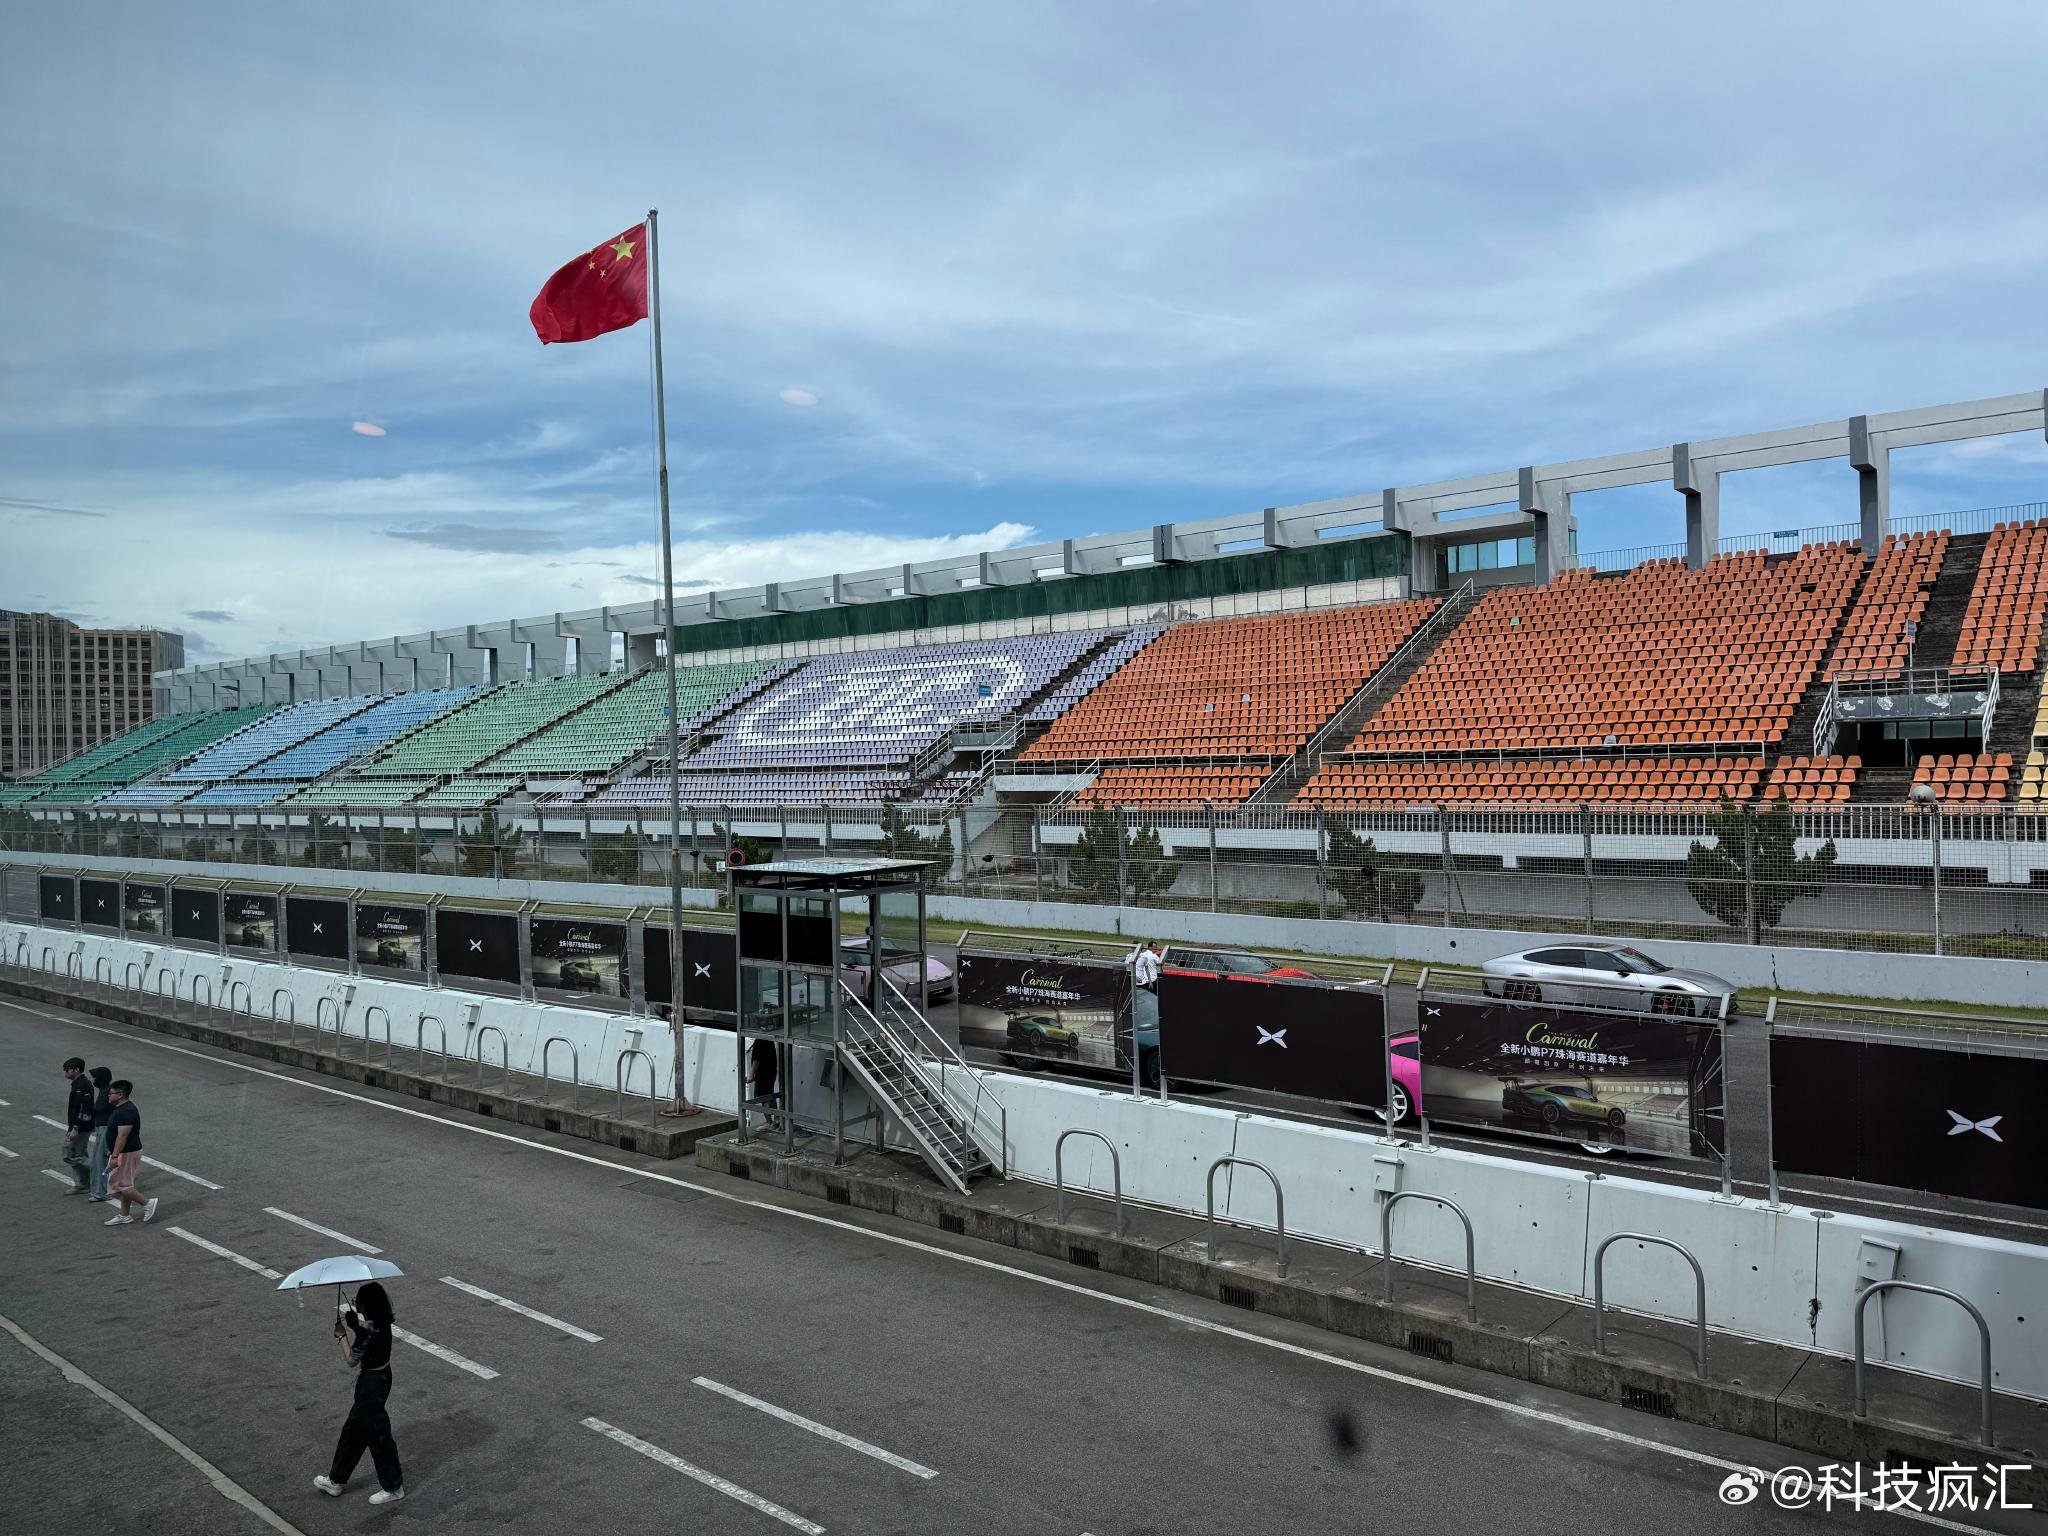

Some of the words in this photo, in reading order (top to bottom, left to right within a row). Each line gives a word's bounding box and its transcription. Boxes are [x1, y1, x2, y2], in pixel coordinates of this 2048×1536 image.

[1020, 968, 1063, 989] Carnival
[1525, 1022, 1599, 1050] Carnival
[1500, 1042, 1629, 1067] 全新小鹏P7珠海赛道嘉年华
